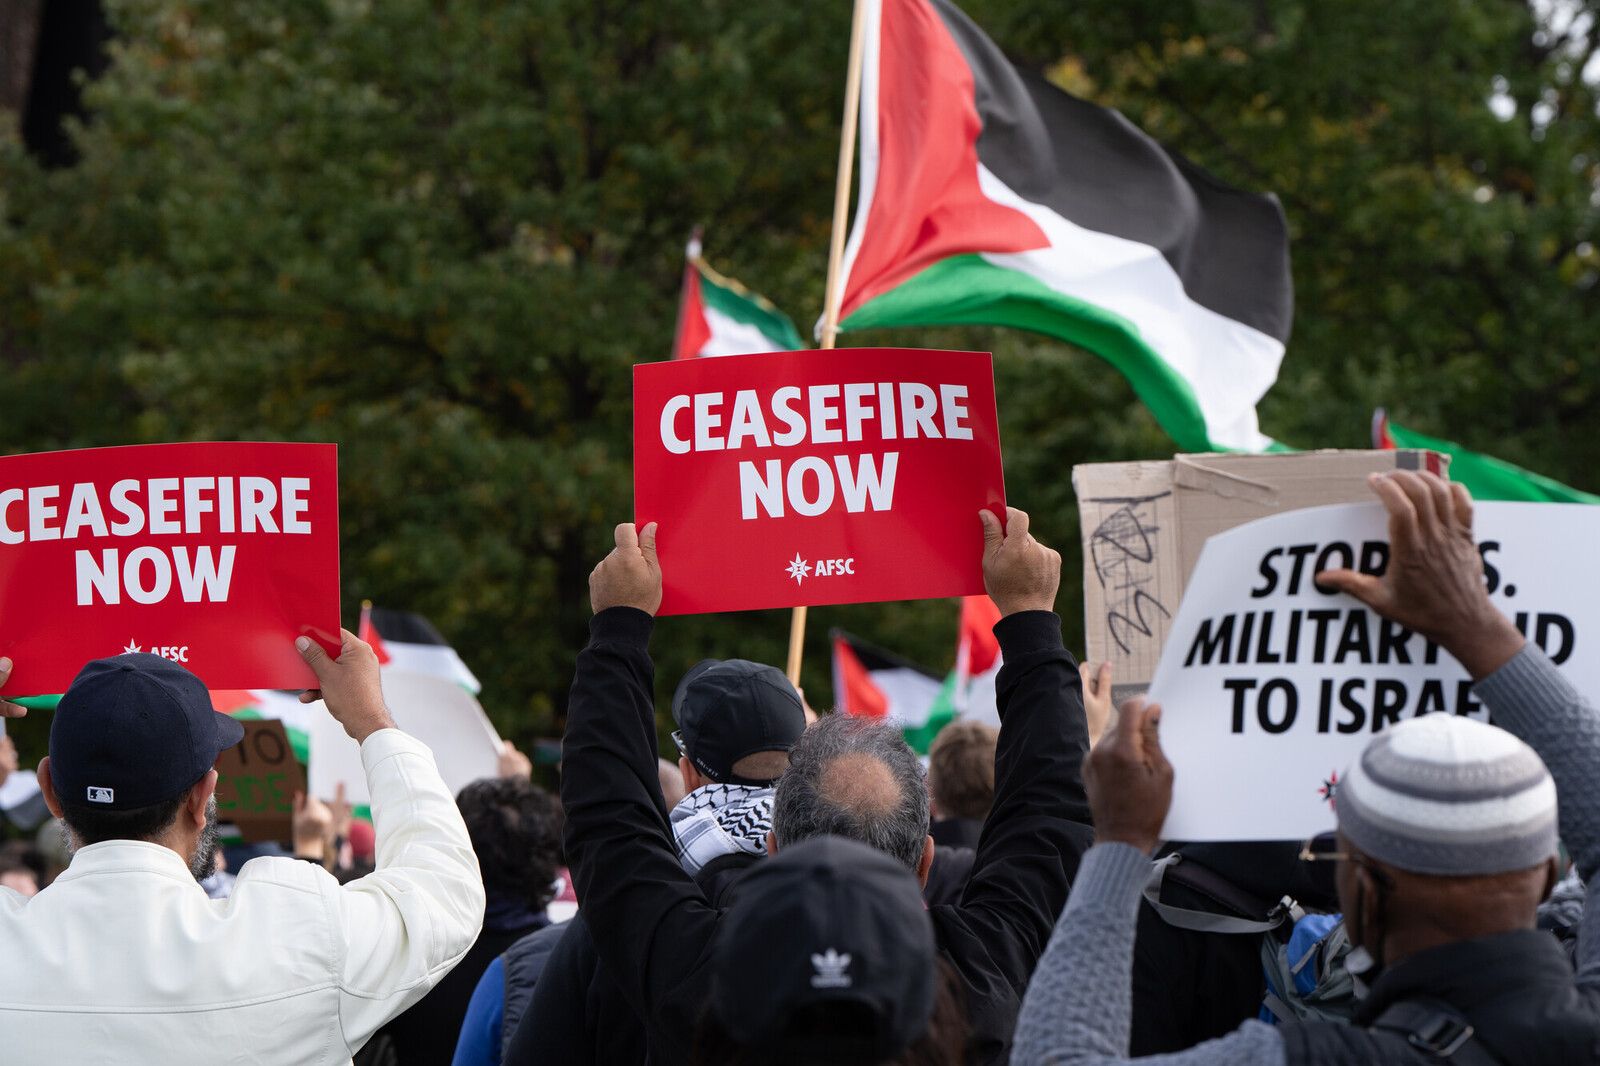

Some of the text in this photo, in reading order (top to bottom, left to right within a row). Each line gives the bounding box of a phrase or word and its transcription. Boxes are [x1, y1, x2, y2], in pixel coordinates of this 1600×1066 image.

[660, 382, 974, 454] CEASEFIRE
[0, 476, 312, 544] CEASEFIRE
[739, 452, 899, 520] NOW
[75, 545, 237, 606] NOW
[814, 558, 855, 577] AFSC
[1251, 540, 1389, 598] STOP
[1223, 677, 1494, 735] TO ISRAE
